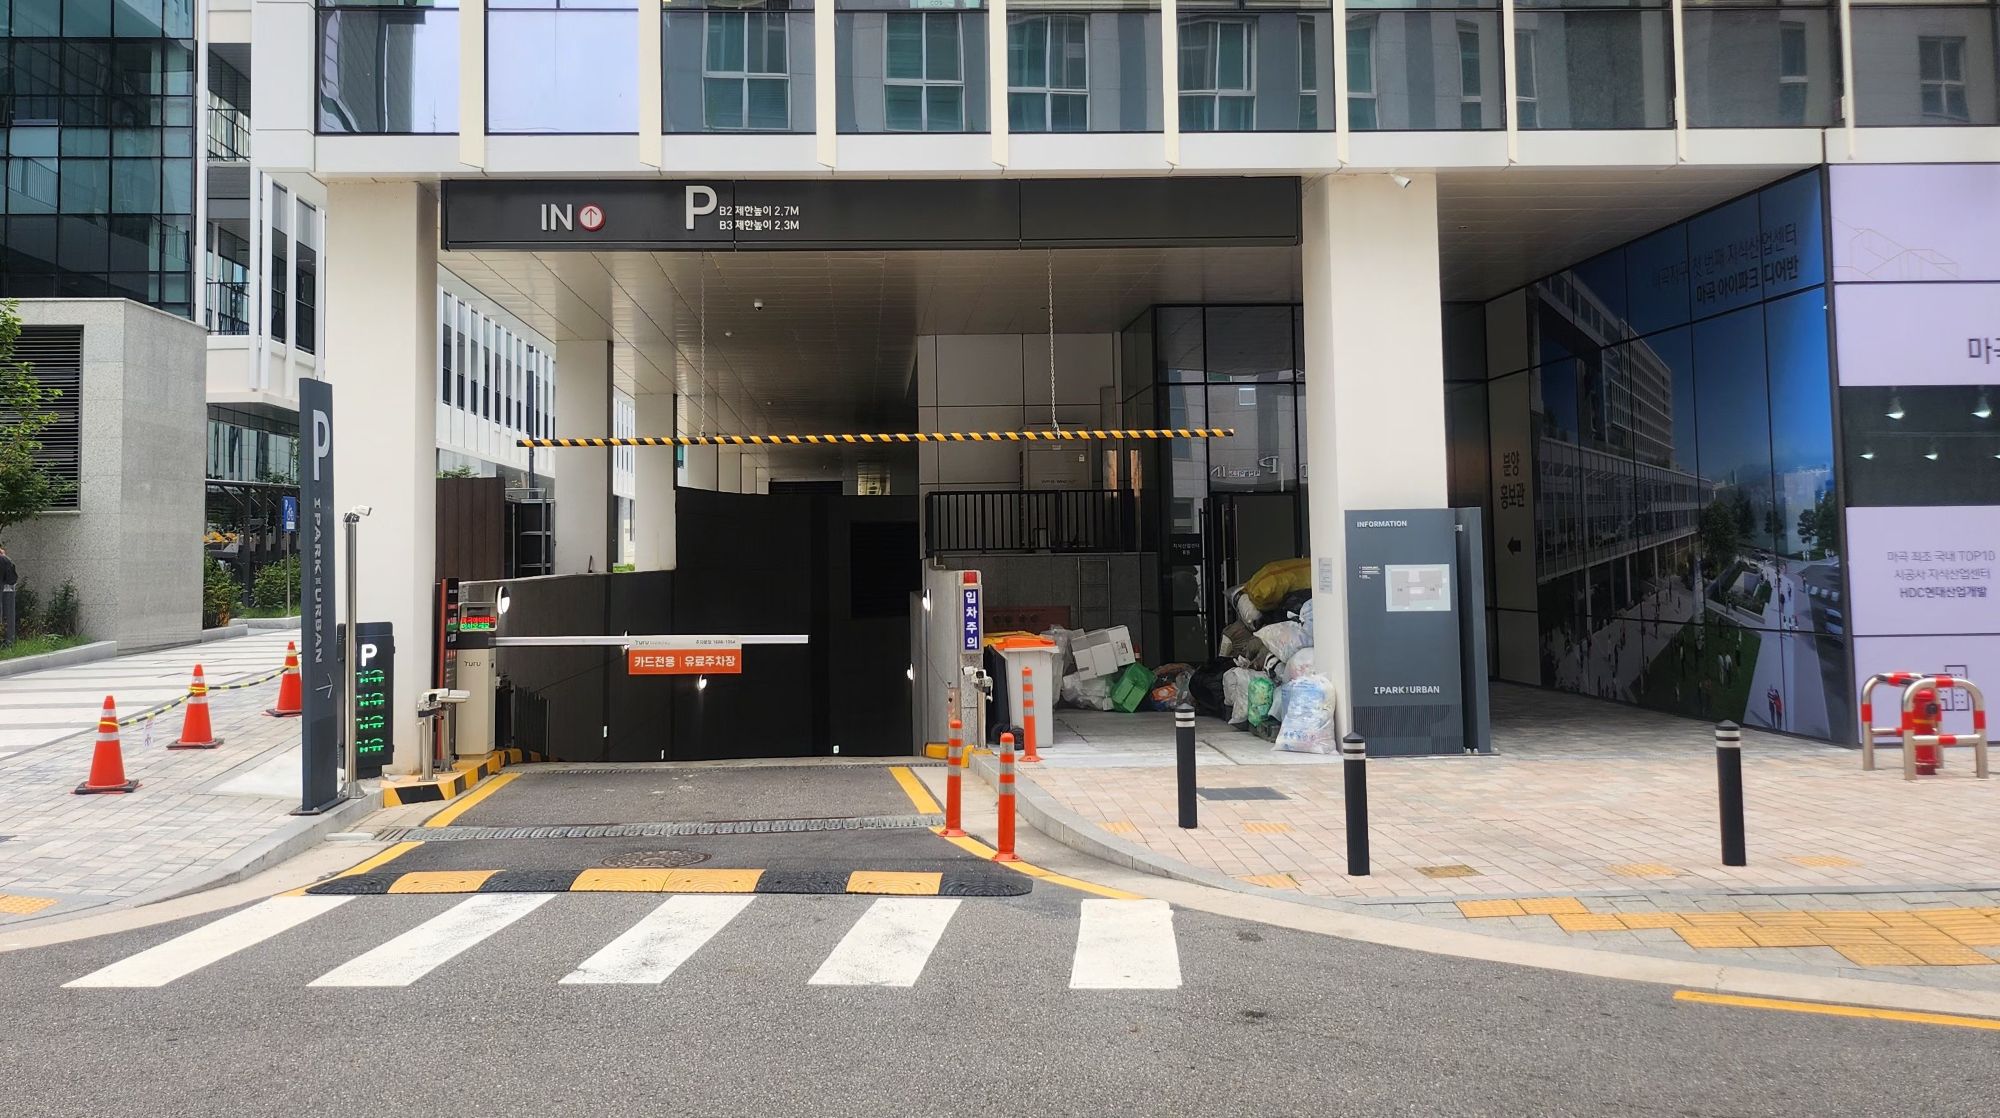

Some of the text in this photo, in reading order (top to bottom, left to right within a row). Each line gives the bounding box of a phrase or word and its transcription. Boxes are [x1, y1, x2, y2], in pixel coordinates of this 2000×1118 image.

[685, 185, 718, 230] P
[719, 205, 800, 216] B2 제한높이 2.7M
[541, 203, 573, 231] IN
[719, 220, 800, 231] B3 제한높이 2.3M
[1696, 255, 1799, 304] 마곡 아이파크 디어반
[313, 409, 331, 481] P
[1356, 520, 1408, 528] INFORMATION
[1887, 551, 1908, 562] 마곡
[1934, 550, 1955, 562] 국내
[1957, 550, 1996, 561] TOP10
[1894, 568, 1991, 581] 시공사 지식산업센터
[965, 591, 978, 649] 입차주의
[361, 643, 378, 667] P
[634, 655, 736, 668] 카드전용 유료주차장
